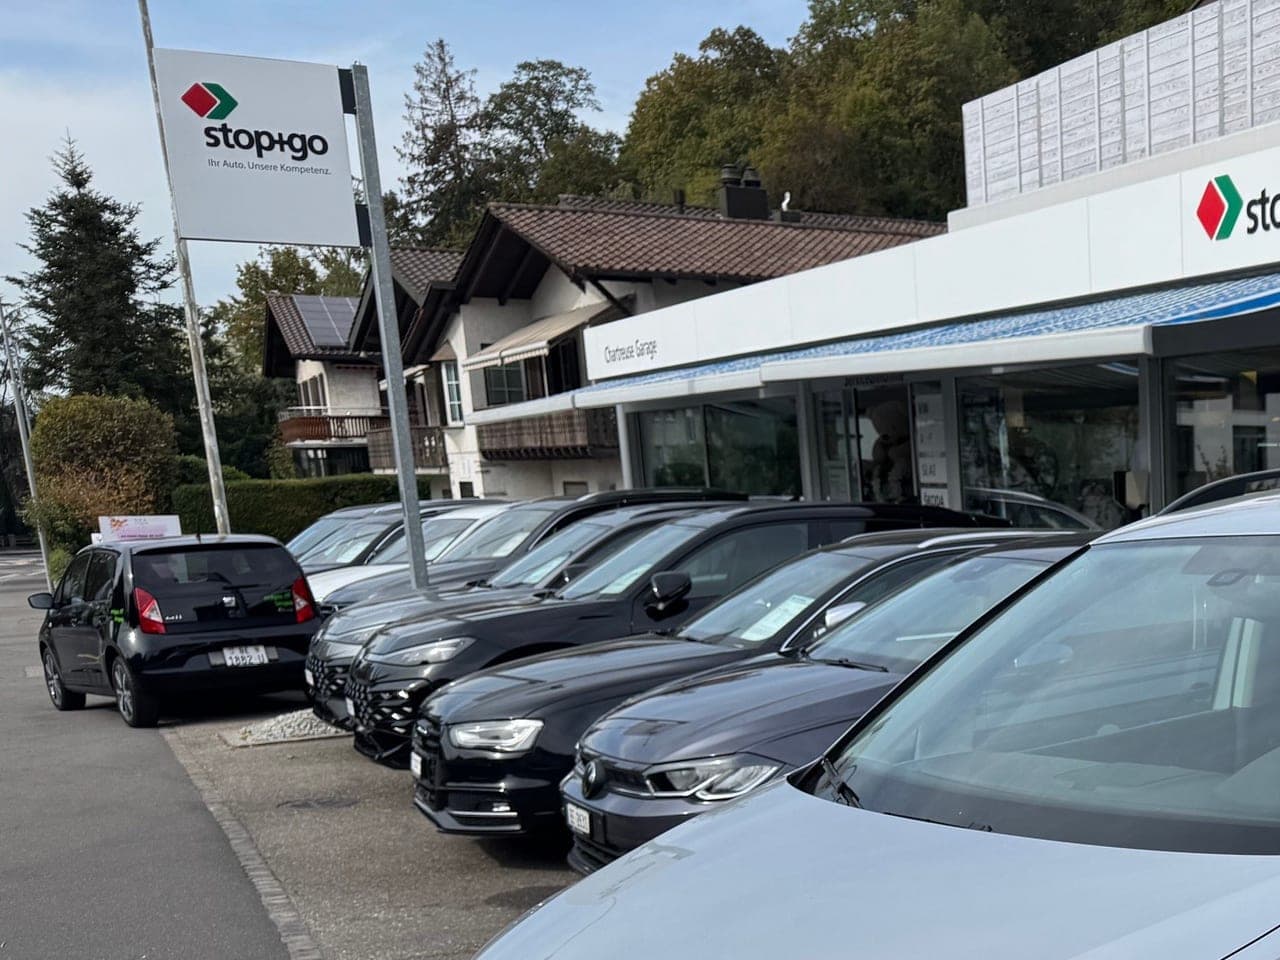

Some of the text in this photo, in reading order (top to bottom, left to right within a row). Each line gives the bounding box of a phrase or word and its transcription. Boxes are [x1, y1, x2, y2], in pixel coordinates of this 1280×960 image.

[204, 122, 329, 161] stop+go
[207, 158, 332, 176] Ihr Auto. Unsere Kompetenz.
[635, 338, 658, 361] Garage
